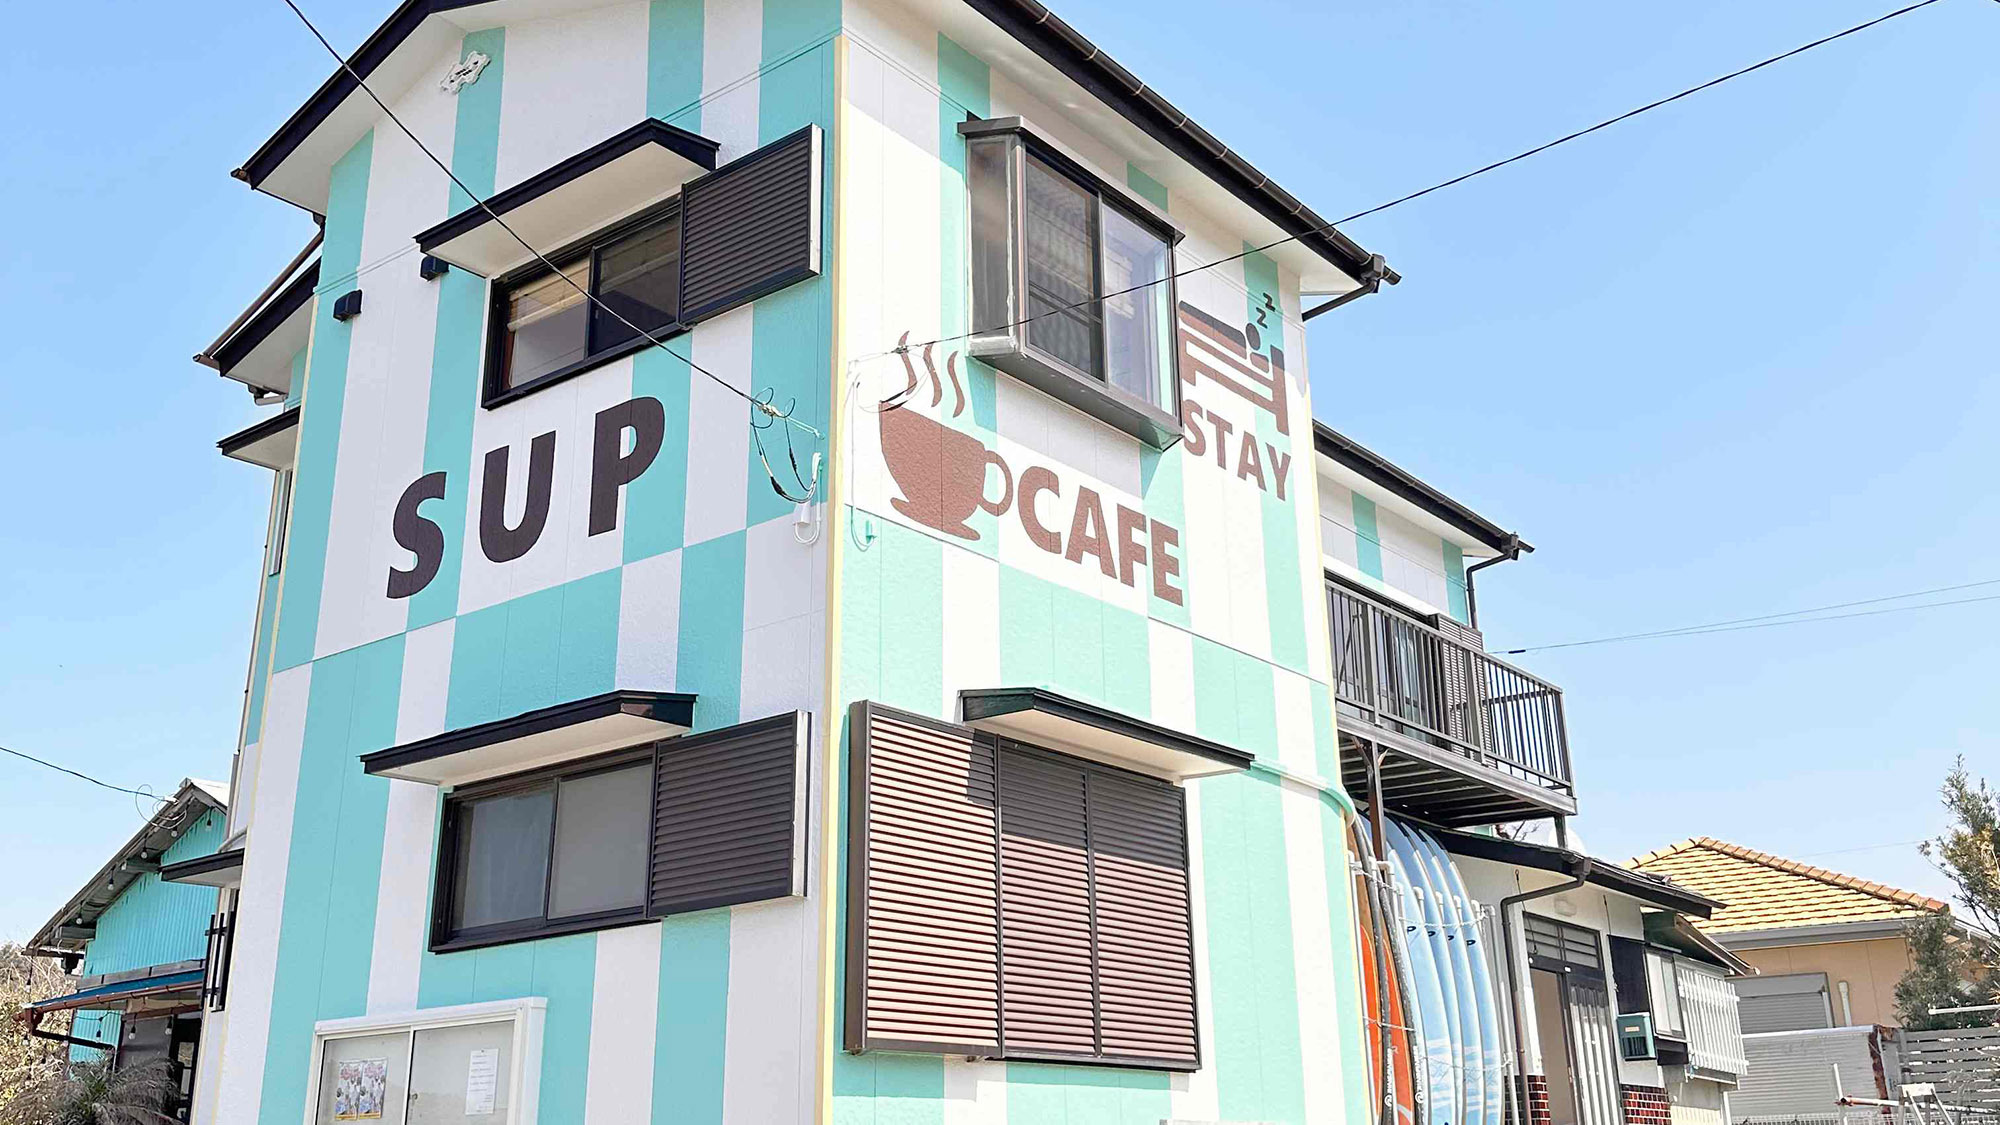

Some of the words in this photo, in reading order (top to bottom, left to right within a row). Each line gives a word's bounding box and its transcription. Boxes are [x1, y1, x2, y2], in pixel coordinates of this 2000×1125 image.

[386, 396, 666, 599] SUP
[1183, 399, 1291, 501] STAY
[1017, 465, 1184, 607] CAFE
